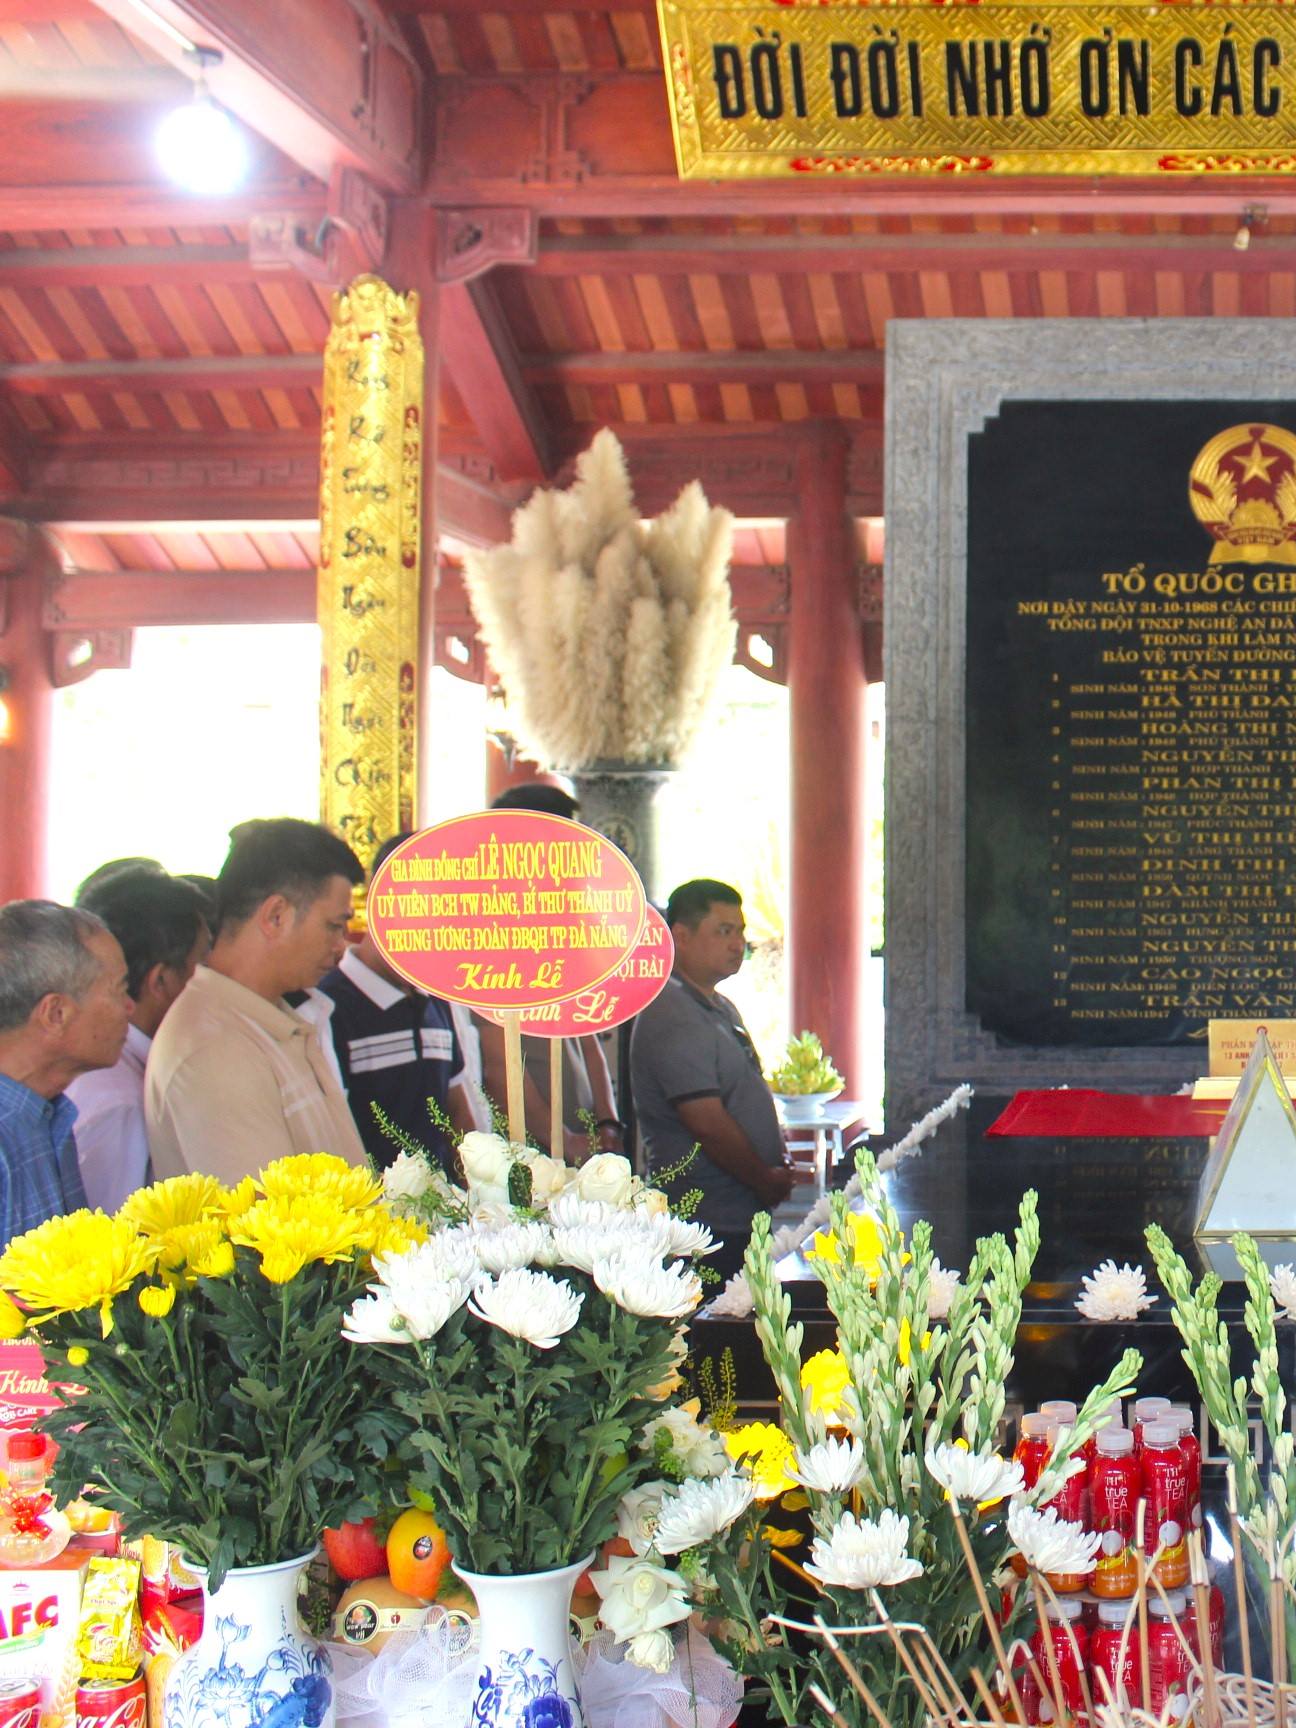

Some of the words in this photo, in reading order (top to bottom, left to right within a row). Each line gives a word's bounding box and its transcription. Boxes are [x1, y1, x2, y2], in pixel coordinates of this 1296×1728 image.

[714, 28, 802, 120] ĐỜI
[830, 28, 923, 120] ĐỜI
[947, 30, 1051, 118] NHỚ
[1078, 38, 1149, 118] ƠN
[1174, 28, 1282, 118] CÁC
[1102, 563, 1146, 593] TỔ
[1154, 565, 1245, 597] QUỐC
[1018, 601, 1048, 614] NƠI
[1091, 599, 1136, 614] NGÀY
[1222, 599, 1255, 613] CÁC
[1048, 613, 1096, 631] TỔNG
[1138, 618, 1184, 630] TNXP
[1188, 614, 1238, 632] NGHỆ
[1242, 618, 1265, 630] AN
[1141, 633, 1202, 645] TRONG
[1207, 633, 1238, 645] KHI
[1244, 631, 1281, 645] LÀM
[1103, 647, 1138, 663] BẢO
[1144, 648, 1166, 665] VỆ
[1229, 669, 1281, 683] THỊ
[1189, 695, 1241, 710] THỊ
[1235, 722, 1278, 736] THỊ
[1231, 777, 1281, 791] THỊ
[391, 860, 409, 882] GIA
[409, 853, 433, 881] ĐÌNH
[433, 850, 461, 881] ĐỒNG
[461, 853, 478, 880] CHÍ
[479, 833, 499, 880] LÊ
[502, 843, 545, 885] NGỌC
[548, 841, 601, 886] QUANG
[1232, 859, 1286, 872] THỊ
[398, 888, 428, 917] VIÊN
[432, 893, 458, 917] BCH
[459, 893, 480, 916] TW
[482, 886, 521, 919] ĐẢNG,
[523, 884, 537, 914] BÍ
[538, 890, 566, 913] THƯ
[567, 884, 614, 913] THÀNH
[386, 929, 432, 952] TRUNG
[435, 926, 471, 951] ƯƠNG
[474, 924, 509, 951] ĐOÀN
[512, 927, 548, 954] ĐBQH
[550, 927, 566, 949] TP
[569, 924, 587, 949] ĐÀ
[589, 914, 628, 949] NẴNG
[638, 955, 664, 978] BÀI
[454, 963, 524, 991] Kính
[529, 960, 565, 989] Lễ
[1165, 1477, 1185, 1488] true
[1105, 1487, 1128, 1498] true
[1165, 1488, 1185, 1499] TEA
[1106, 1498, 1127, 1509] TEA
